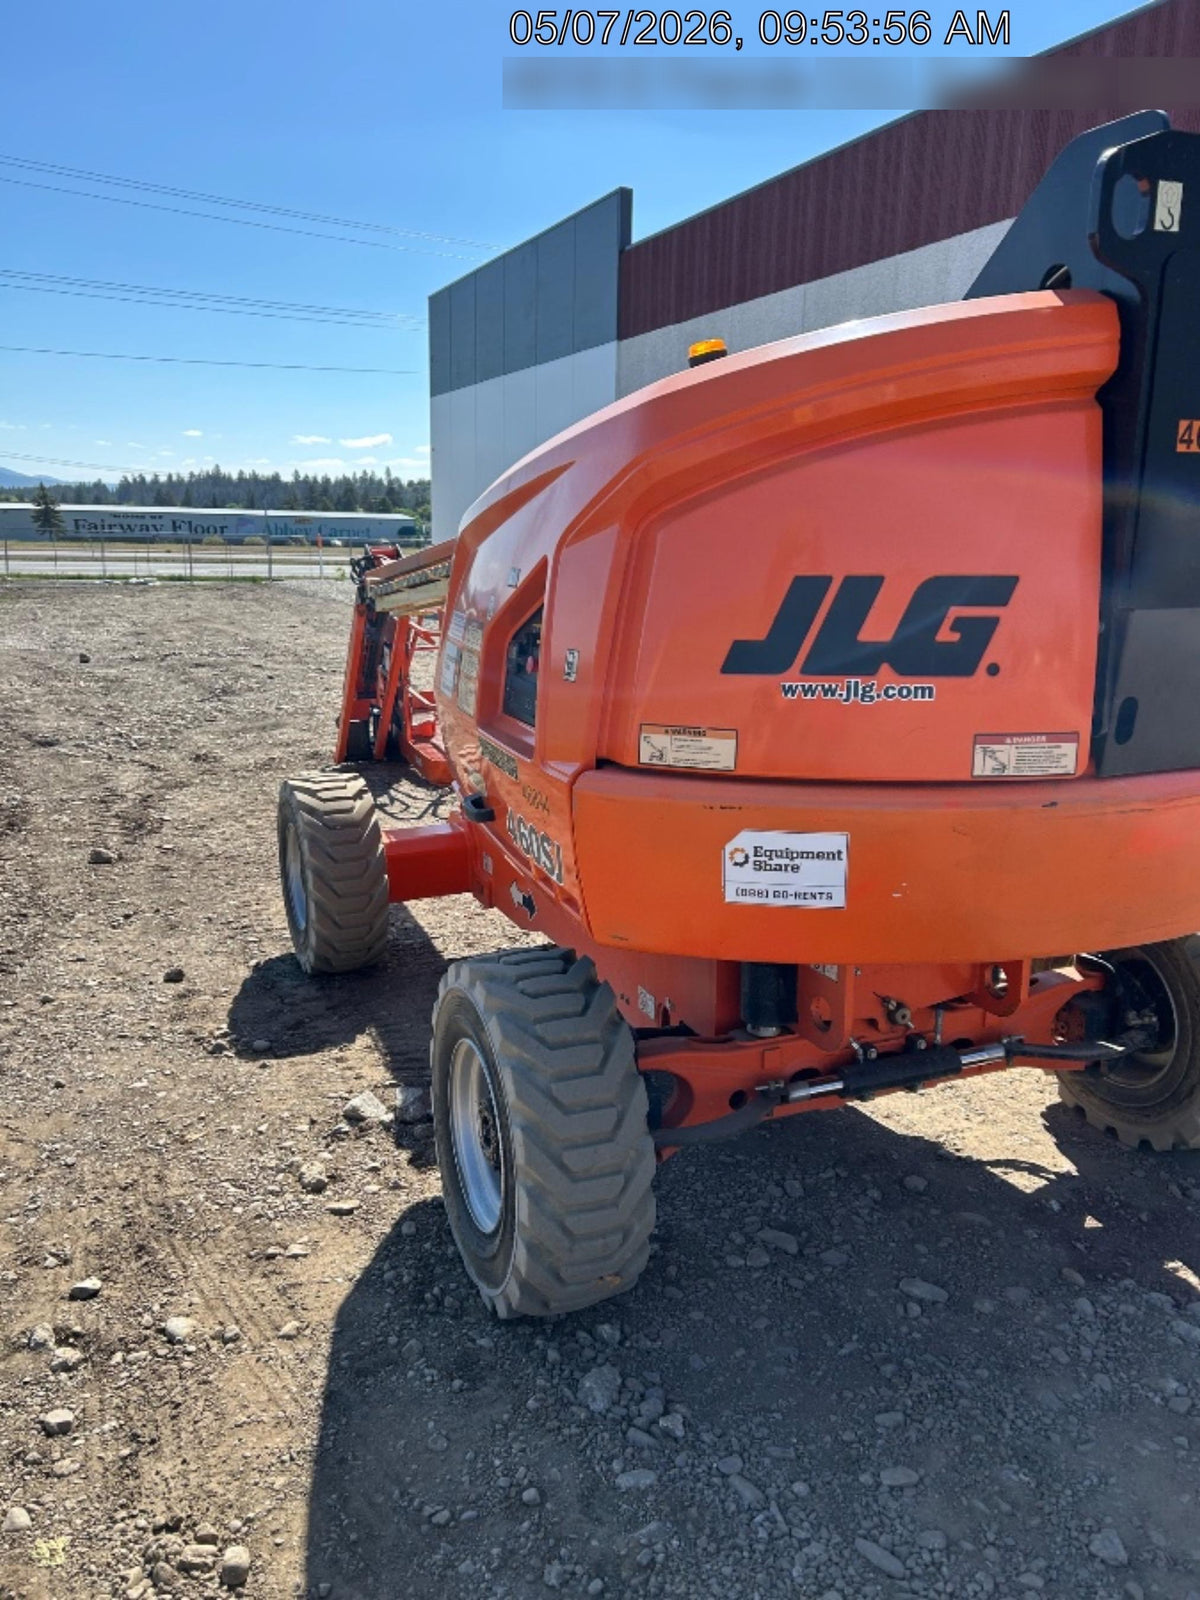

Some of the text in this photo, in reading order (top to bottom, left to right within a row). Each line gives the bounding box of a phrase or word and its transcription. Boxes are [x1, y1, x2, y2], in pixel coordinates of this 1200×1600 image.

[73, 518, 228, 534] Fairway Floor
[781, 679, 935, 703] www.jlg.com
[753, 845, 844, 862] Equipment
[753, 860, 801, 874] Share
